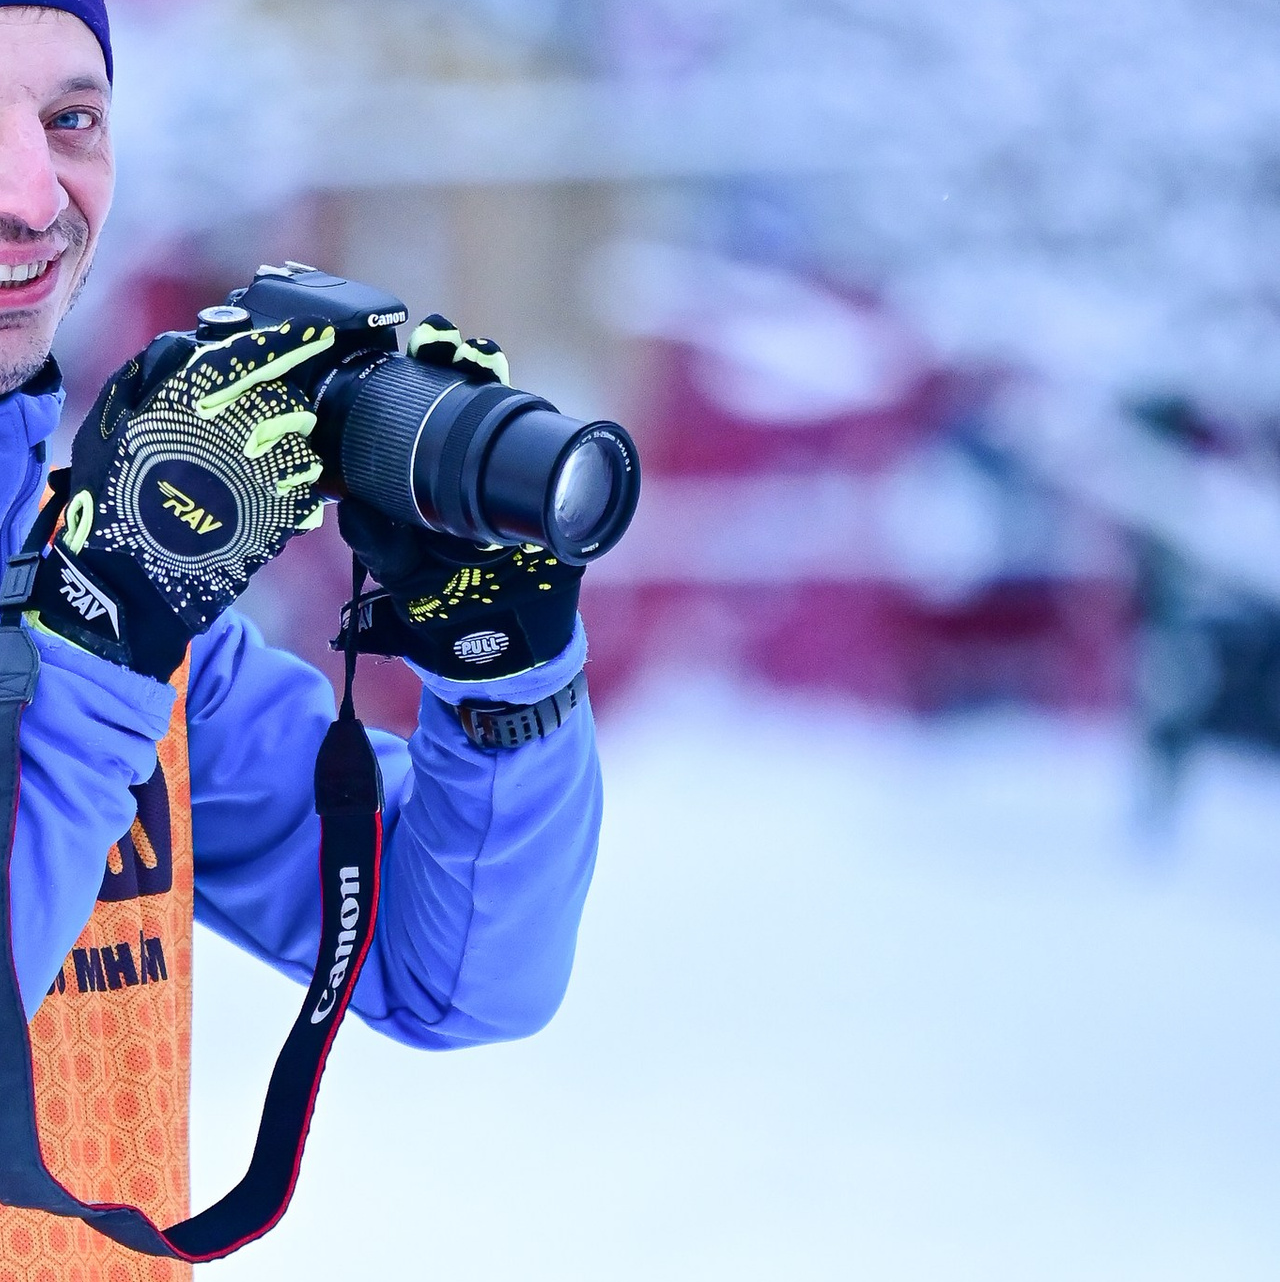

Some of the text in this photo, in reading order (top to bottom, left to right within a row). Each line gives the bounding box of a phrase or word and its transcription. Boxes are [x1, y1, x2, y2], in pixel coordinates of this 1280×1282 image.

[367, 311, 406, 327] Canon
[461, 637, 500, 656] PULL
[310, 866, 360, 1024] Canon
